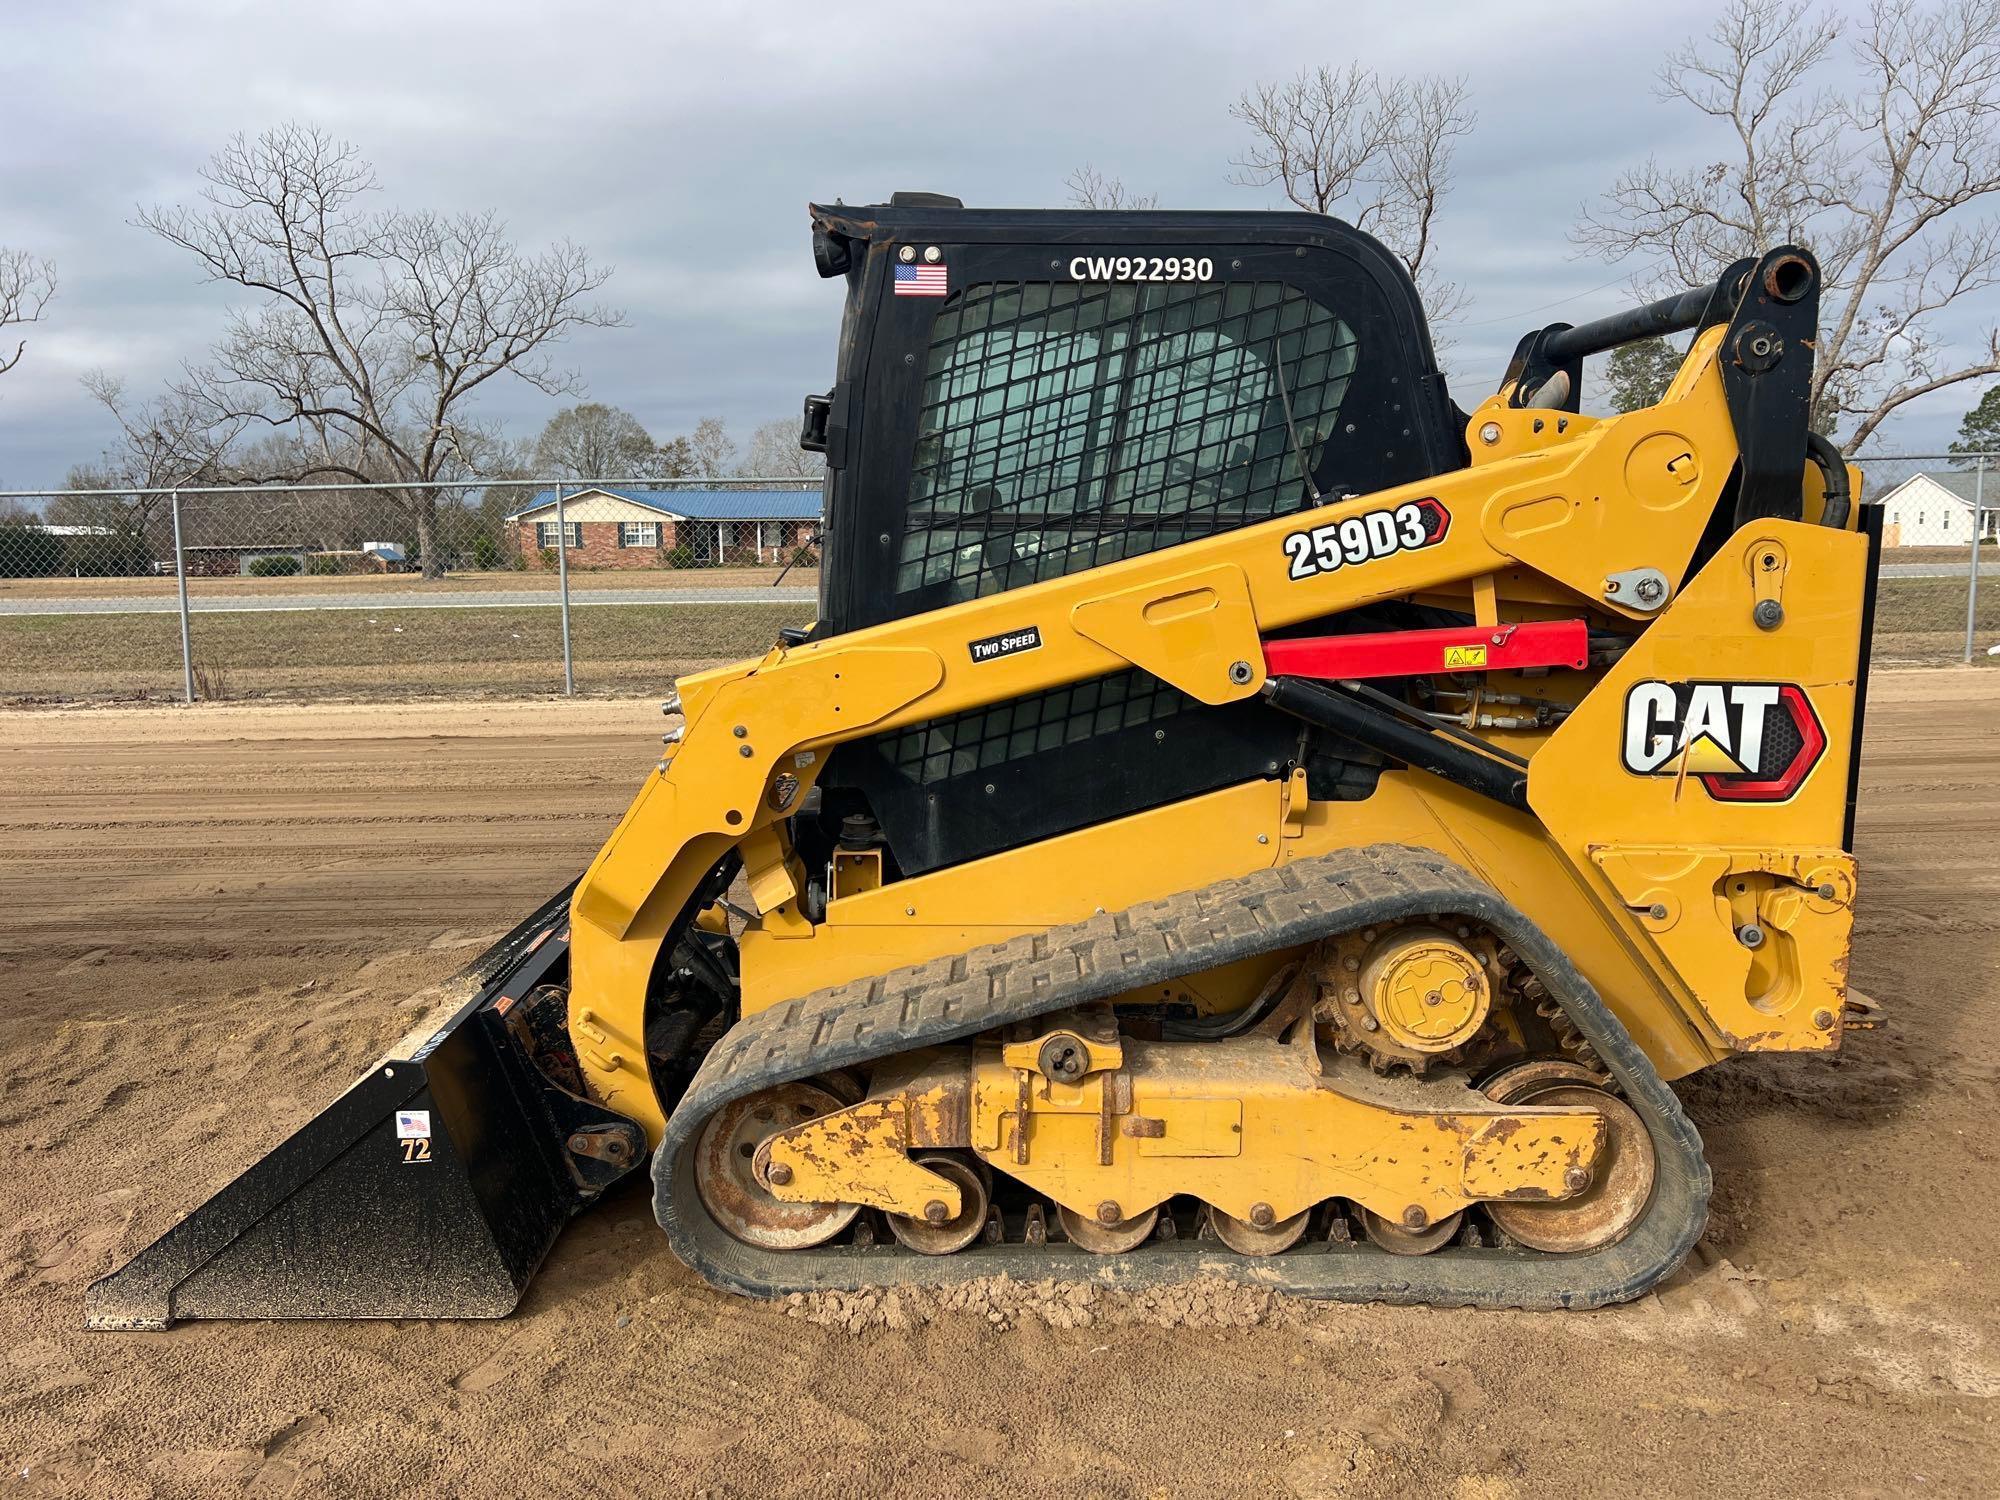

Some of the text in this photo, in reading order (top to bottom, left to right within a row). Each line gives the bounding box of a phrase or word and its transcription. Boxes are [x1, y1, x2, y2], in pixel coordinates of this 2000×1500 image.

[1069, 256, 1214, 281] CW922930
[1285, 503, 1427, 579] 259D3
[1625, 682, 1780, 774] CAT
[400, 1138, 431, 1160] 72
